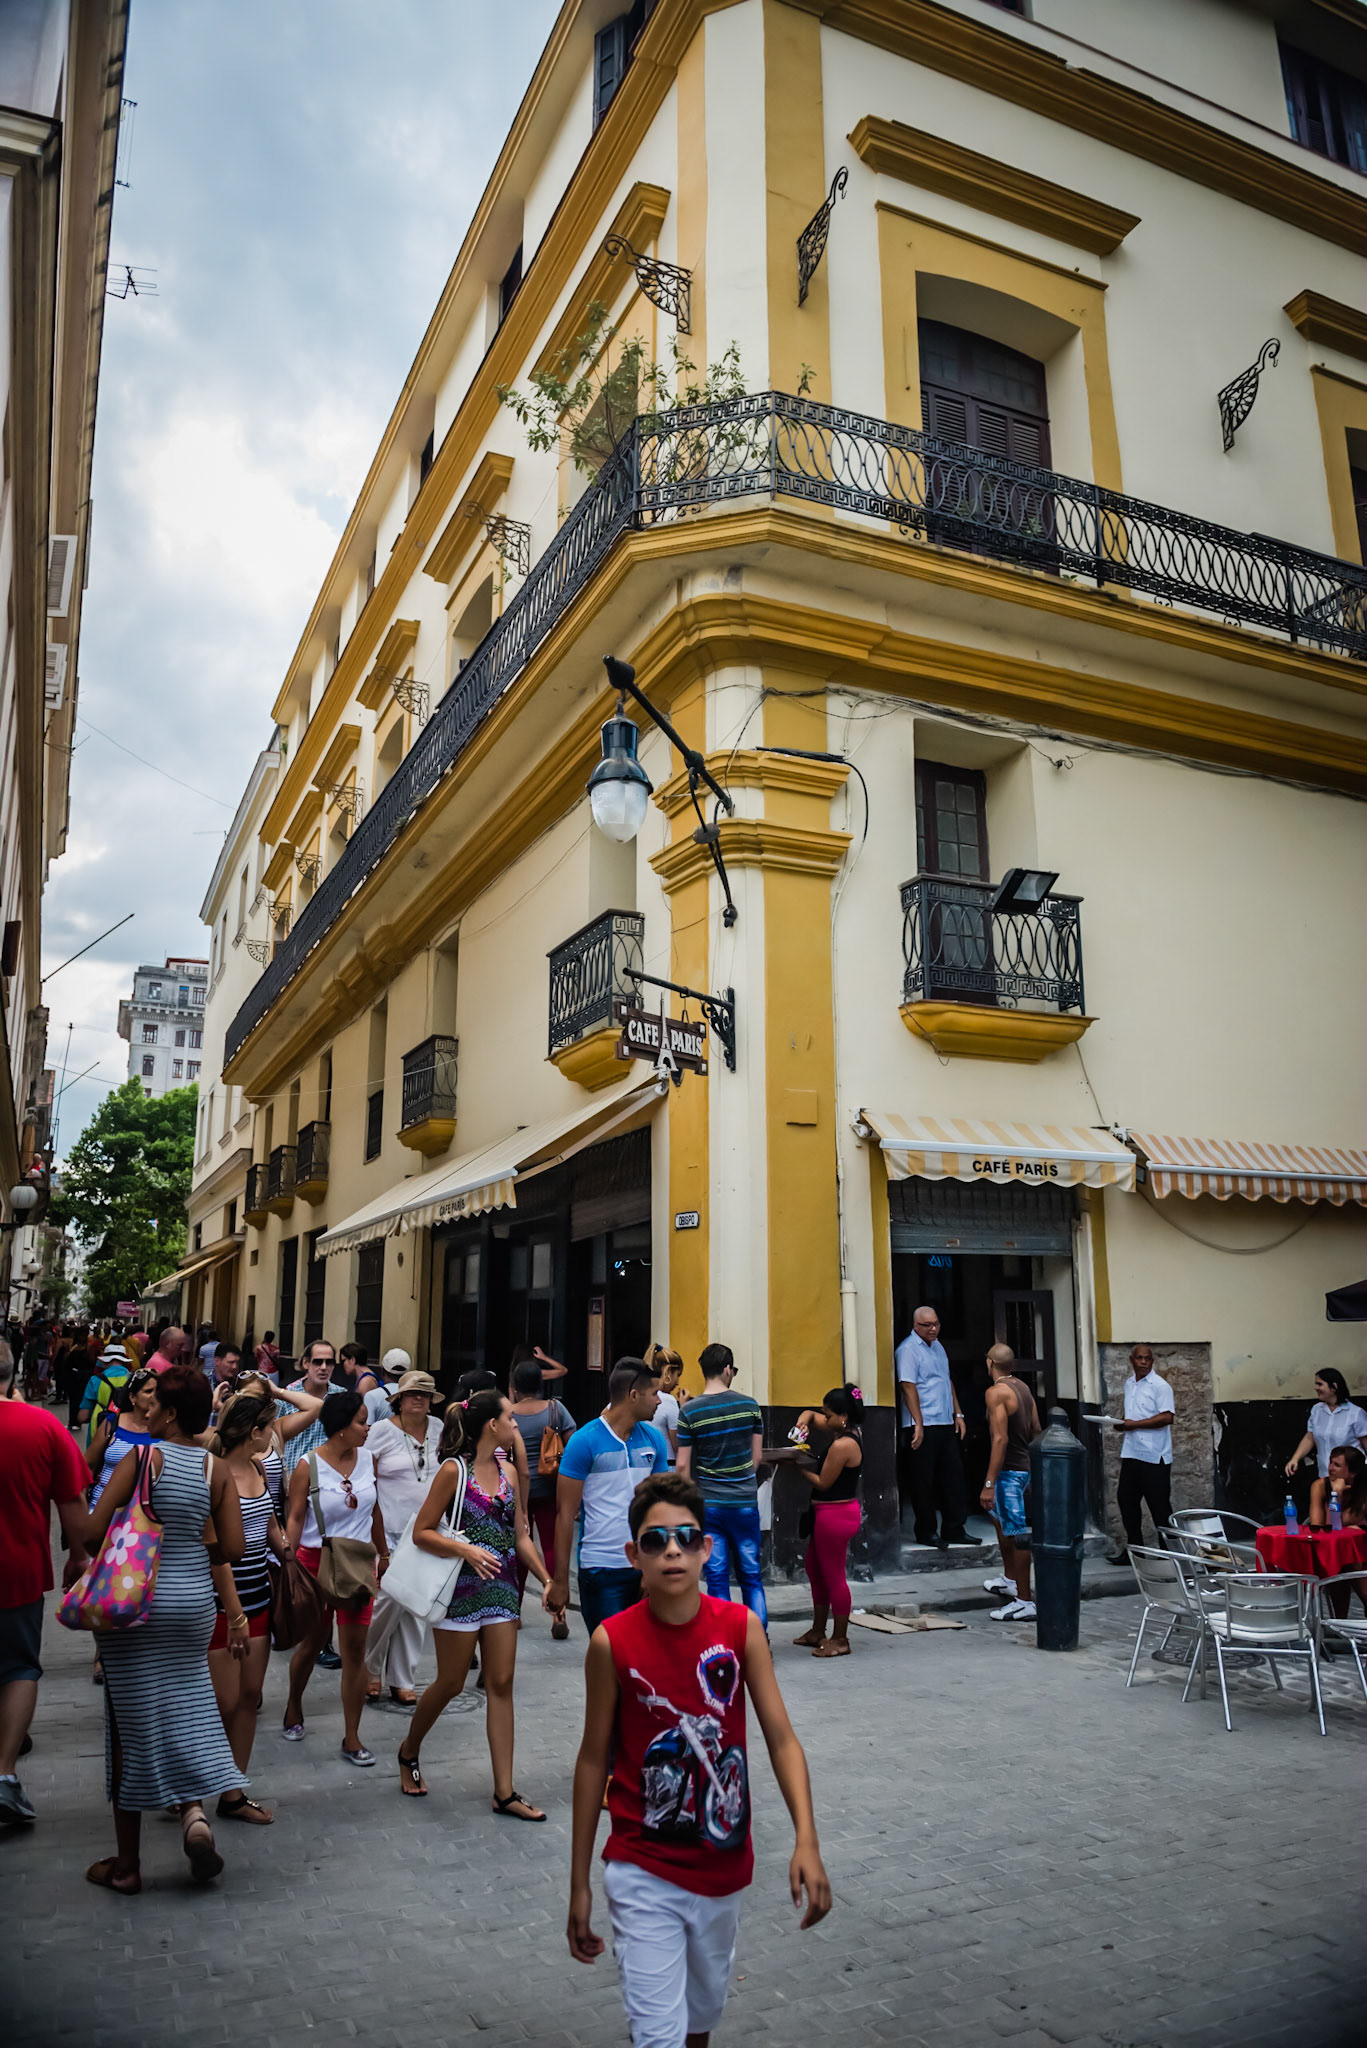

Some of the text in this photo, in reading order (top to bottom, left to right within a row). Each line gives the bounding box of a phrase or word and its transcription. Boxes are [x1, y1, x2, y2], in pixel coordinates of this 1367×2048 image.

[628, 1019, 702, 1057] CAFE PARIS
[972, 1159, 1059, 1177] CAFÉ PARÍS
[700, 1643, 726, 1663] MAKE
